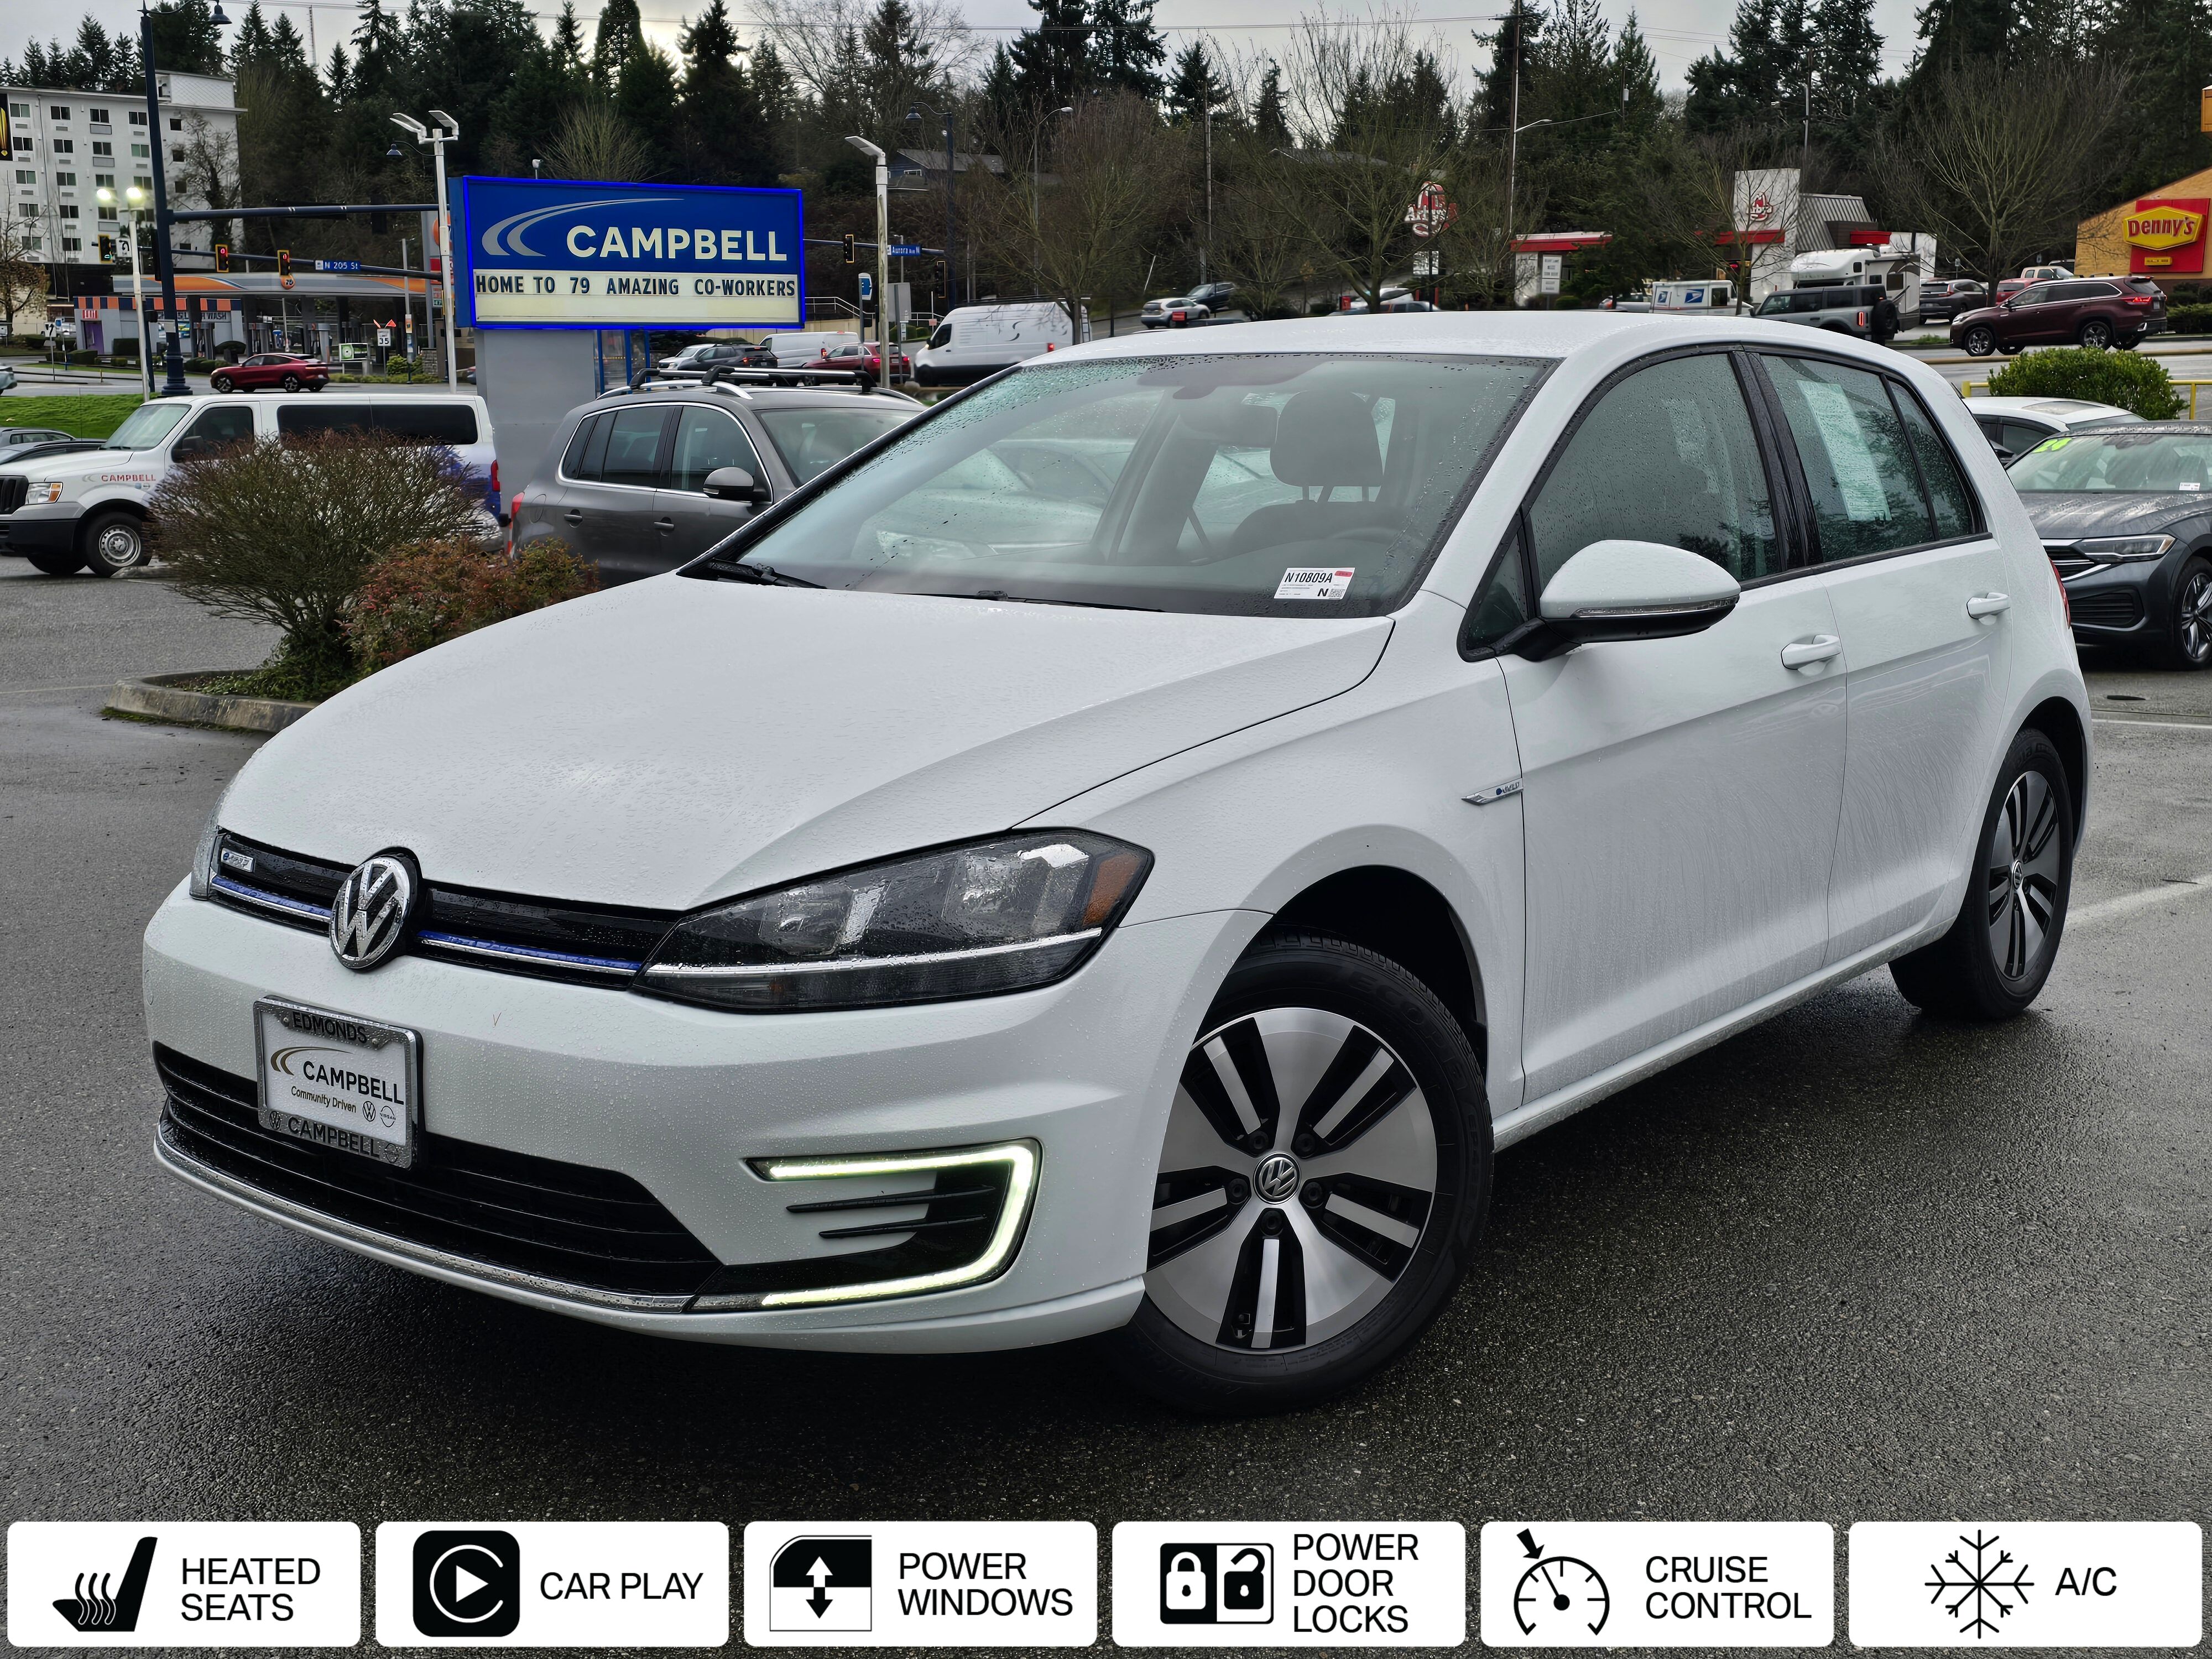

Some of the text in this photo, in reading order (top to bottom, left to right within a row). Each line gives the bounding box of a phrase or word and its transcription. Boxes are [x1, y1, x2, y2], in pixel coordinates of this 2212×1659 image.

[2127, 217, 2195, 237] Denny's
[566, 224, 787, 262] CAMPBELL
[476, 275, 795, 296] HOME TO 79 AMAZING CO-WORKERS
[1284, 572, 1333, 583] N10809A
[293, 1012, 367, 1044] EDMONDS
[303, 1061, 404, 1105] CAMPBELL
[291, 1086, 357, 1113] Community Driven
[288, 1116, 380, 1159] CAMPBELL
